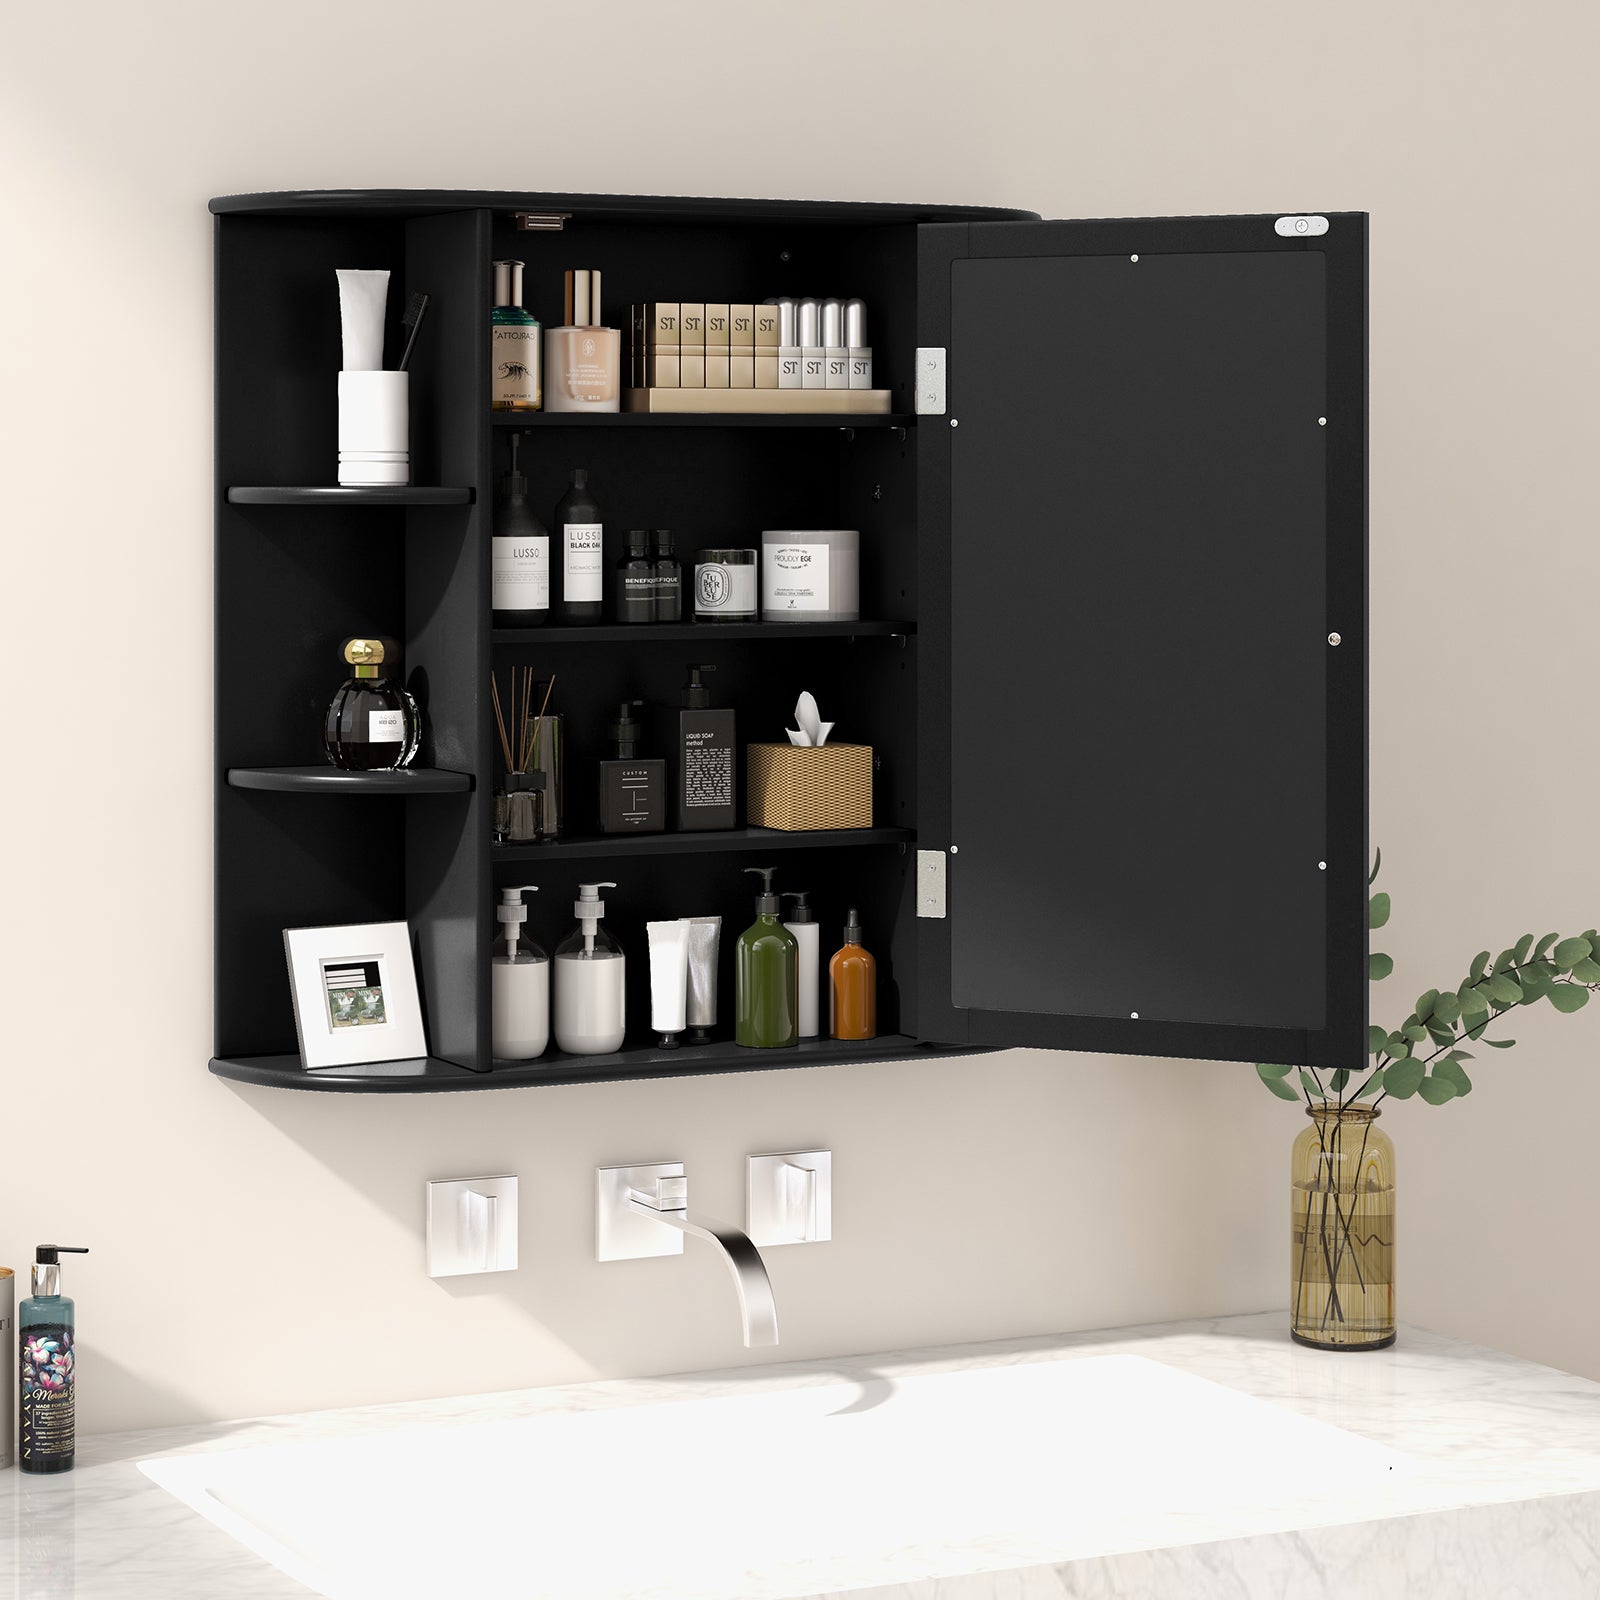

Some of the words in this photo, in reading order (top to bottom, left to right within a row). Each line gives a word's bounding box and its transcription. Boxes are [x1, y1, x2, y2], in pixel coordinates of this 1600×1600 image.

[660, 317, 676, 330] ST
[686, 318, 700, 331] ST
[710, 318, 725, 331] ST
[735, 318, 750, 332] ST
[760, 318, 774, 332] ST
[783, 362, 798, 374] ST
[806, 362, 822, 374] ST
[830, 362, 845, 375] ST
[854, 362, 868, 375] ST
[513, 548, 540, 558] LUSSO
